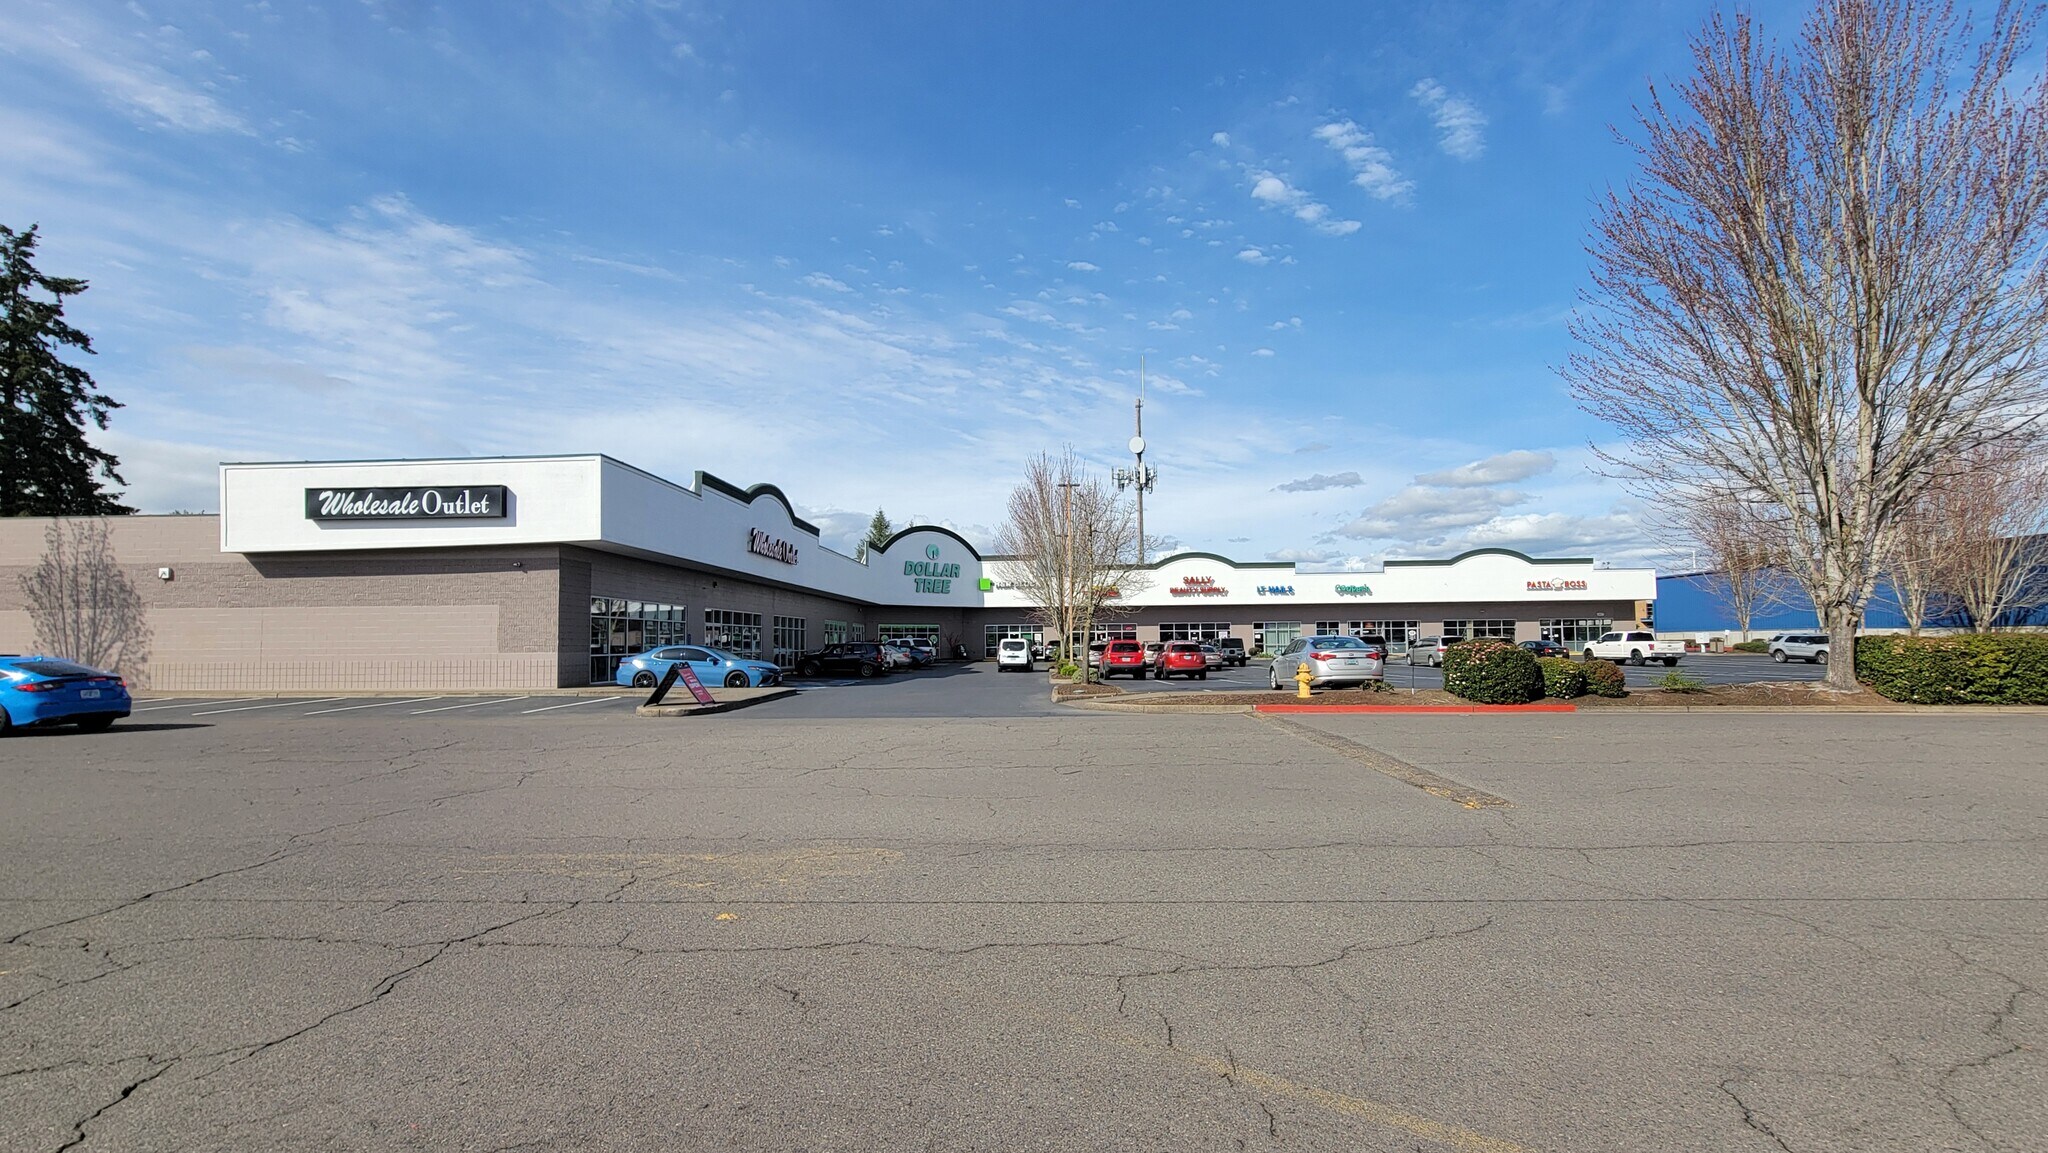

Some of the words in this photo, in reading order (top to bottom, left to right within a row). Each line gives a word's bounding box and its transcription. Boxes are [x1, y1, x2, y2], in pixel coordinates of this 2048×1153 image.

[318, 490, 420, 516] Wholesale
[421, 490, 490, 515] Outlet
[903, 561, 960, 578] DOLLAR
[914, 578, 951, 594] TREE
[1183, 575, 1213, 585] SALLY
[1527, 581, 1552, 589] PASTA
[1564, 580, 1586, 588] BOSS
